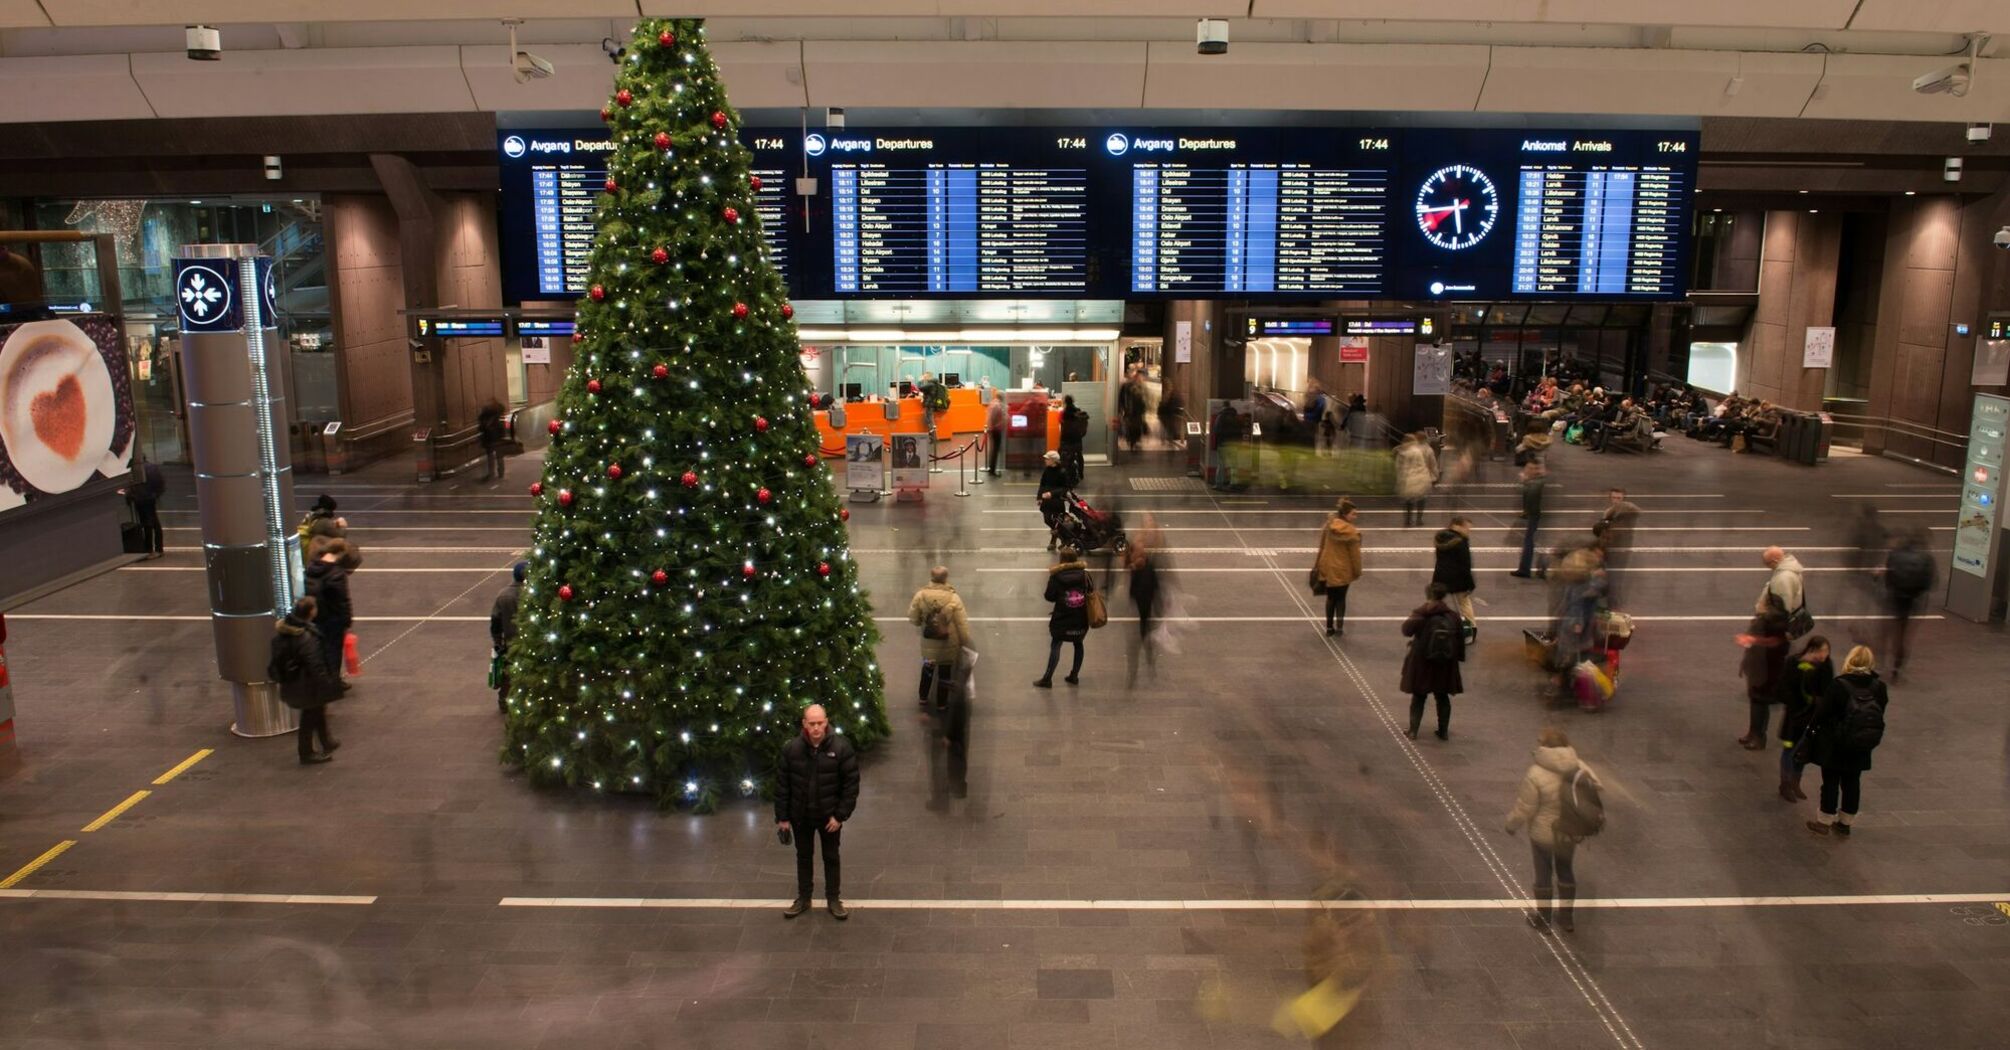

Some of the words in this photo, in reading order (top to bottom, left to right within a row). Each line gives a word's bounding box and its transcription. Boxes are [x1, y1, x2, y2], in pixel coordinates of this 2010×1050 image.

[531, 140, 570, 153] Avgang
[755, 139, 783, 149] 17:44
[831, 138, 871, 151] Avgang
[876, 138, 933, 151] Departures
[1057, 138, 1086, 148] 17:44
[1134, 138, 1174, 151] Avgang
[1179, 138, 1236, 151] Departures
[1360, 139, 1388, 149] 17:44
[1522, 140, 1566, 151] Ankomst
[1573, 141, 1612, 151] Arrivals
[1658, 142, 1685, 152] 17:44
[421, 326, 427, 335] 7
[1249, 325, 1255, 334] 9
[1422, 325, 1432, 334] 10
